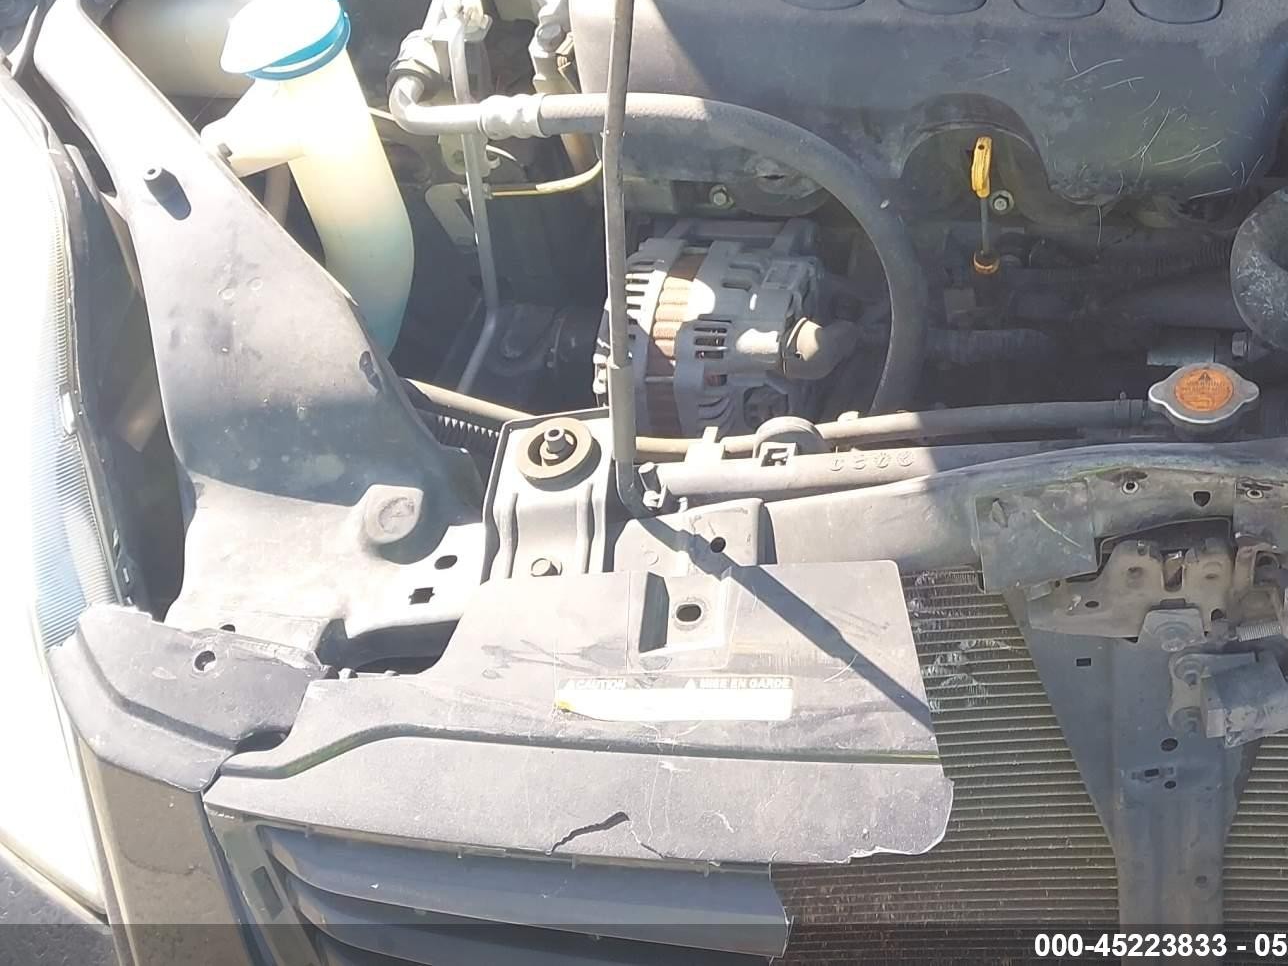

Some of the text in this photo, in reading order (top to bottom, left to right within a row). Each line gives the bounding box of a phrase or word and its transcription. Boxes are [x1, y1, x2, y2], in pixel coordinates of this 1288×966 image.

[576, 679, 626, 690] CAUTION
[699, 678, 792, 689] MISE EN GARDE
